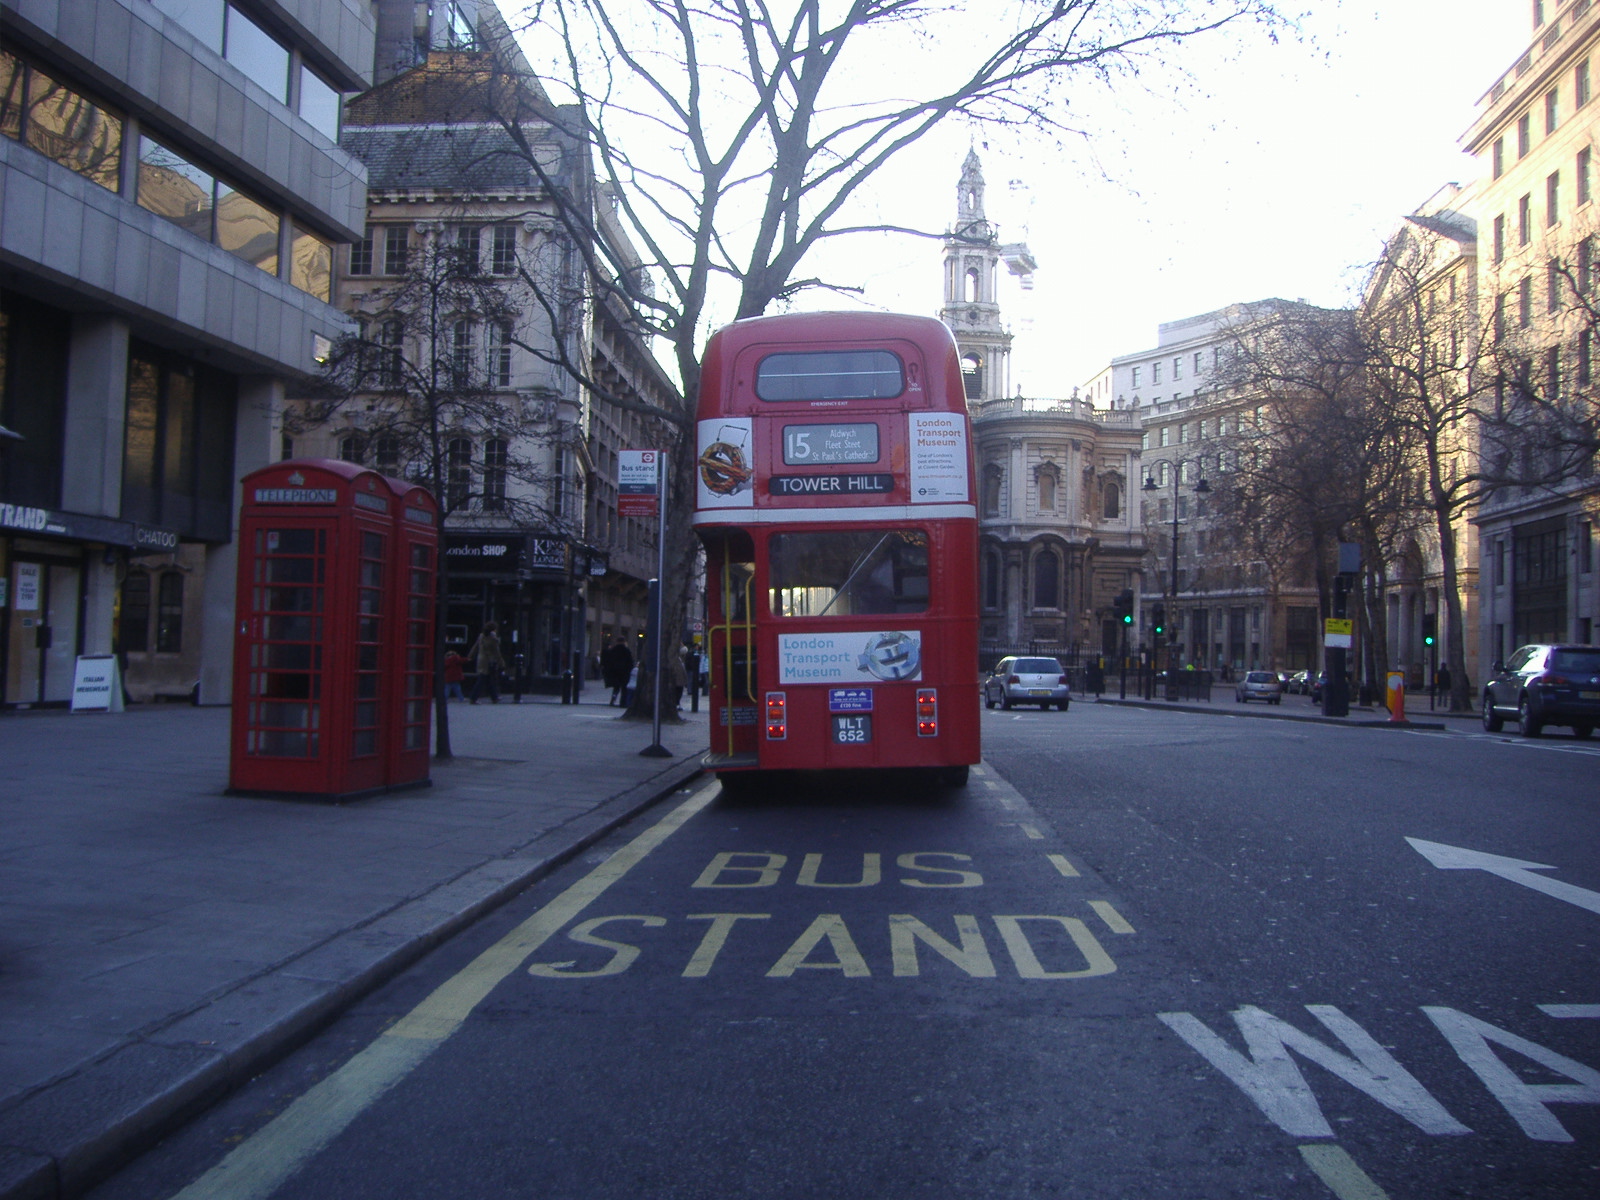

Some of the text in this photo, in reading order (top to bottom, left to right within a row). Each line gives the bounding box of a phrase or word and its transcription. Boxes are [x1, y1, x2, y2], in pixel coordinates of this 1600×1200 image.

[916, 419, 952, 427] London
[829, 429, 857, 439] Aldwych
[917, 429, 961, 438] Transport
[788, 433, 811, 459] 15
[825, 440, 862, 449] Fleet Street
[917, 439, 957, 447] Museum
[812, 452, 820, 461] St
[821, 451, 842, 461] Paul's
[621, 464, 634, 472] Bus
[779, 476, 883, 492] TOWER HILL
[260, 489, 334, 501] TELEPHONE
[446, 544, 507, 557] ondon SHOP
[21, 568, 36, 576] SALE
[590, 568, 607, 576] SHOP
[784, 638, 834, 649] London
[784, 652, 850, 665] Transport
[785, 667, 841, 678] Museum
[838, 717, 864, 729] WLT
[838, 730, 864, 741] 652
[691, 851, 984, 889] BUS
[528, 913, 1118, 980] STAND
